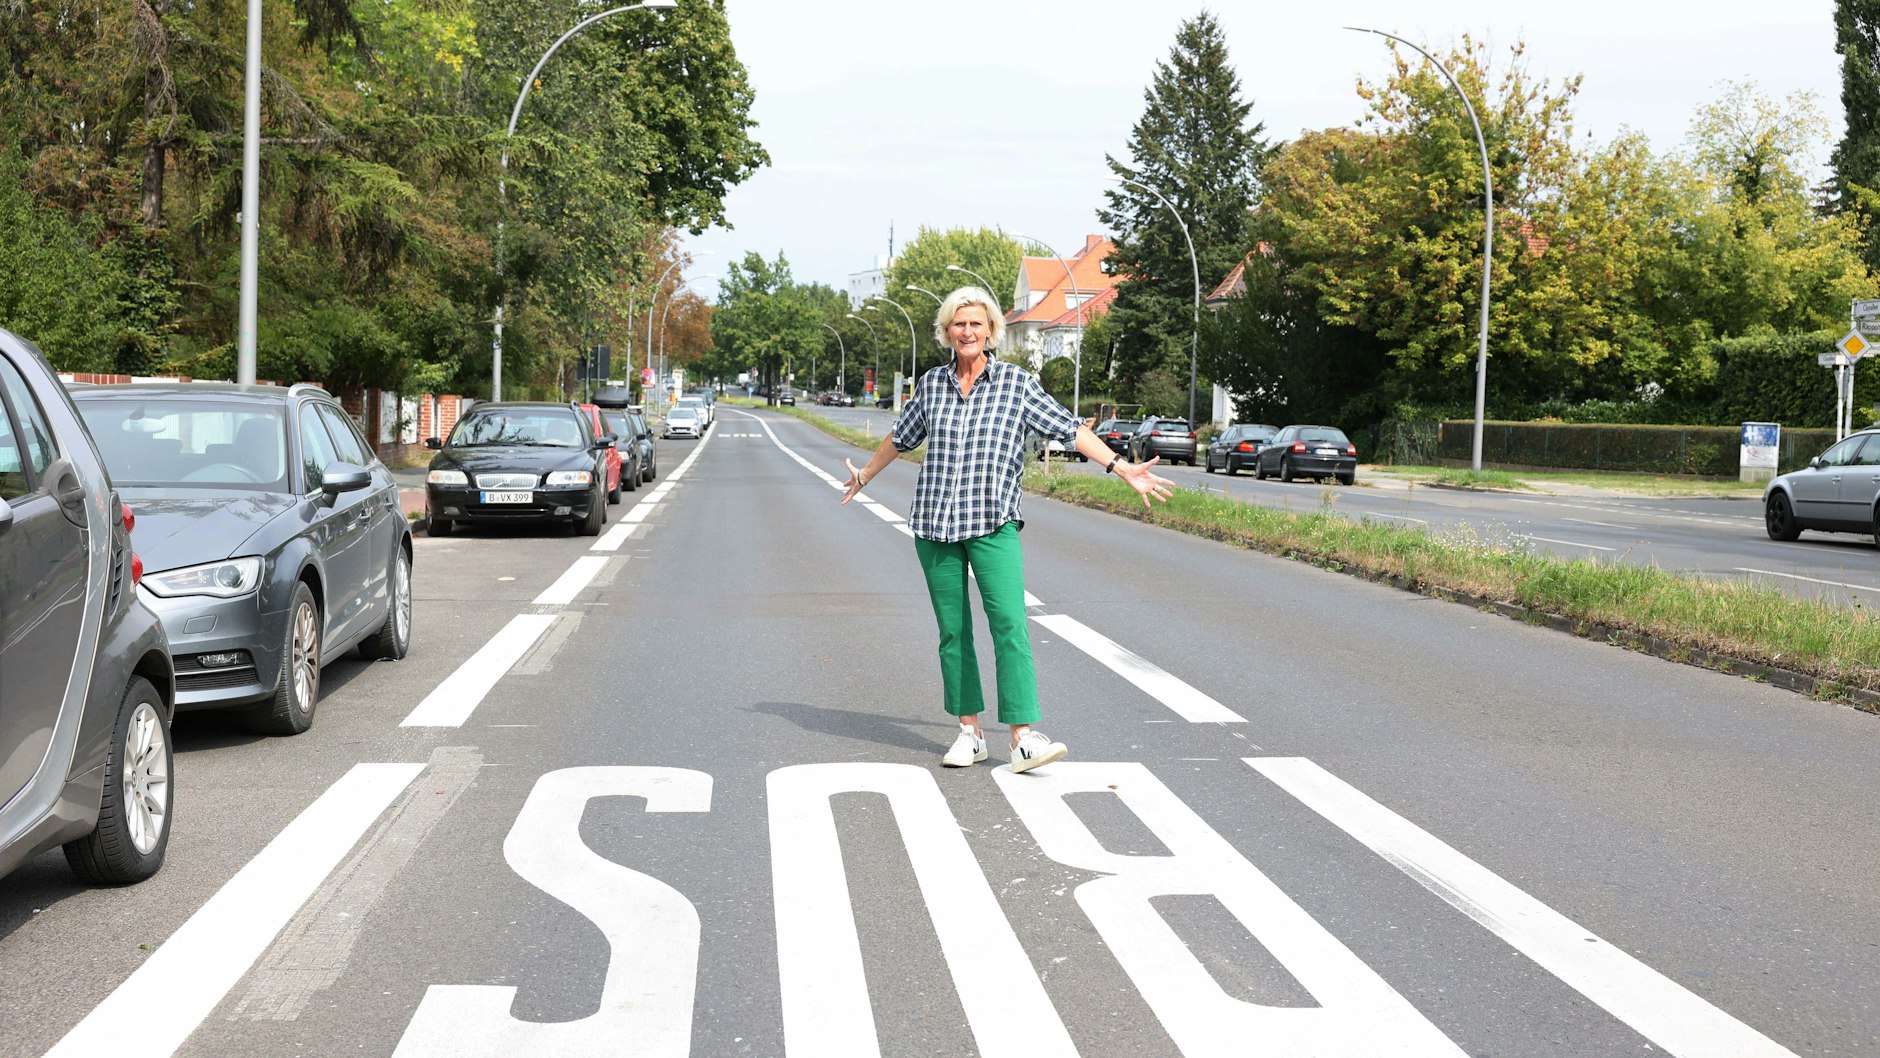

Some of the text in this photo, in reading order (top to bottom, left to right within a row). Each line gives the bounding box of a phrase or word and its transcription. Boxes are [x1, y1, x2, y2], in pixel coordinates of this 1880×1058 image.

[489, 493, 495, 502] B
[513, 493, 529, 502] 399
[392, 761, 1473, 1058] BUS
